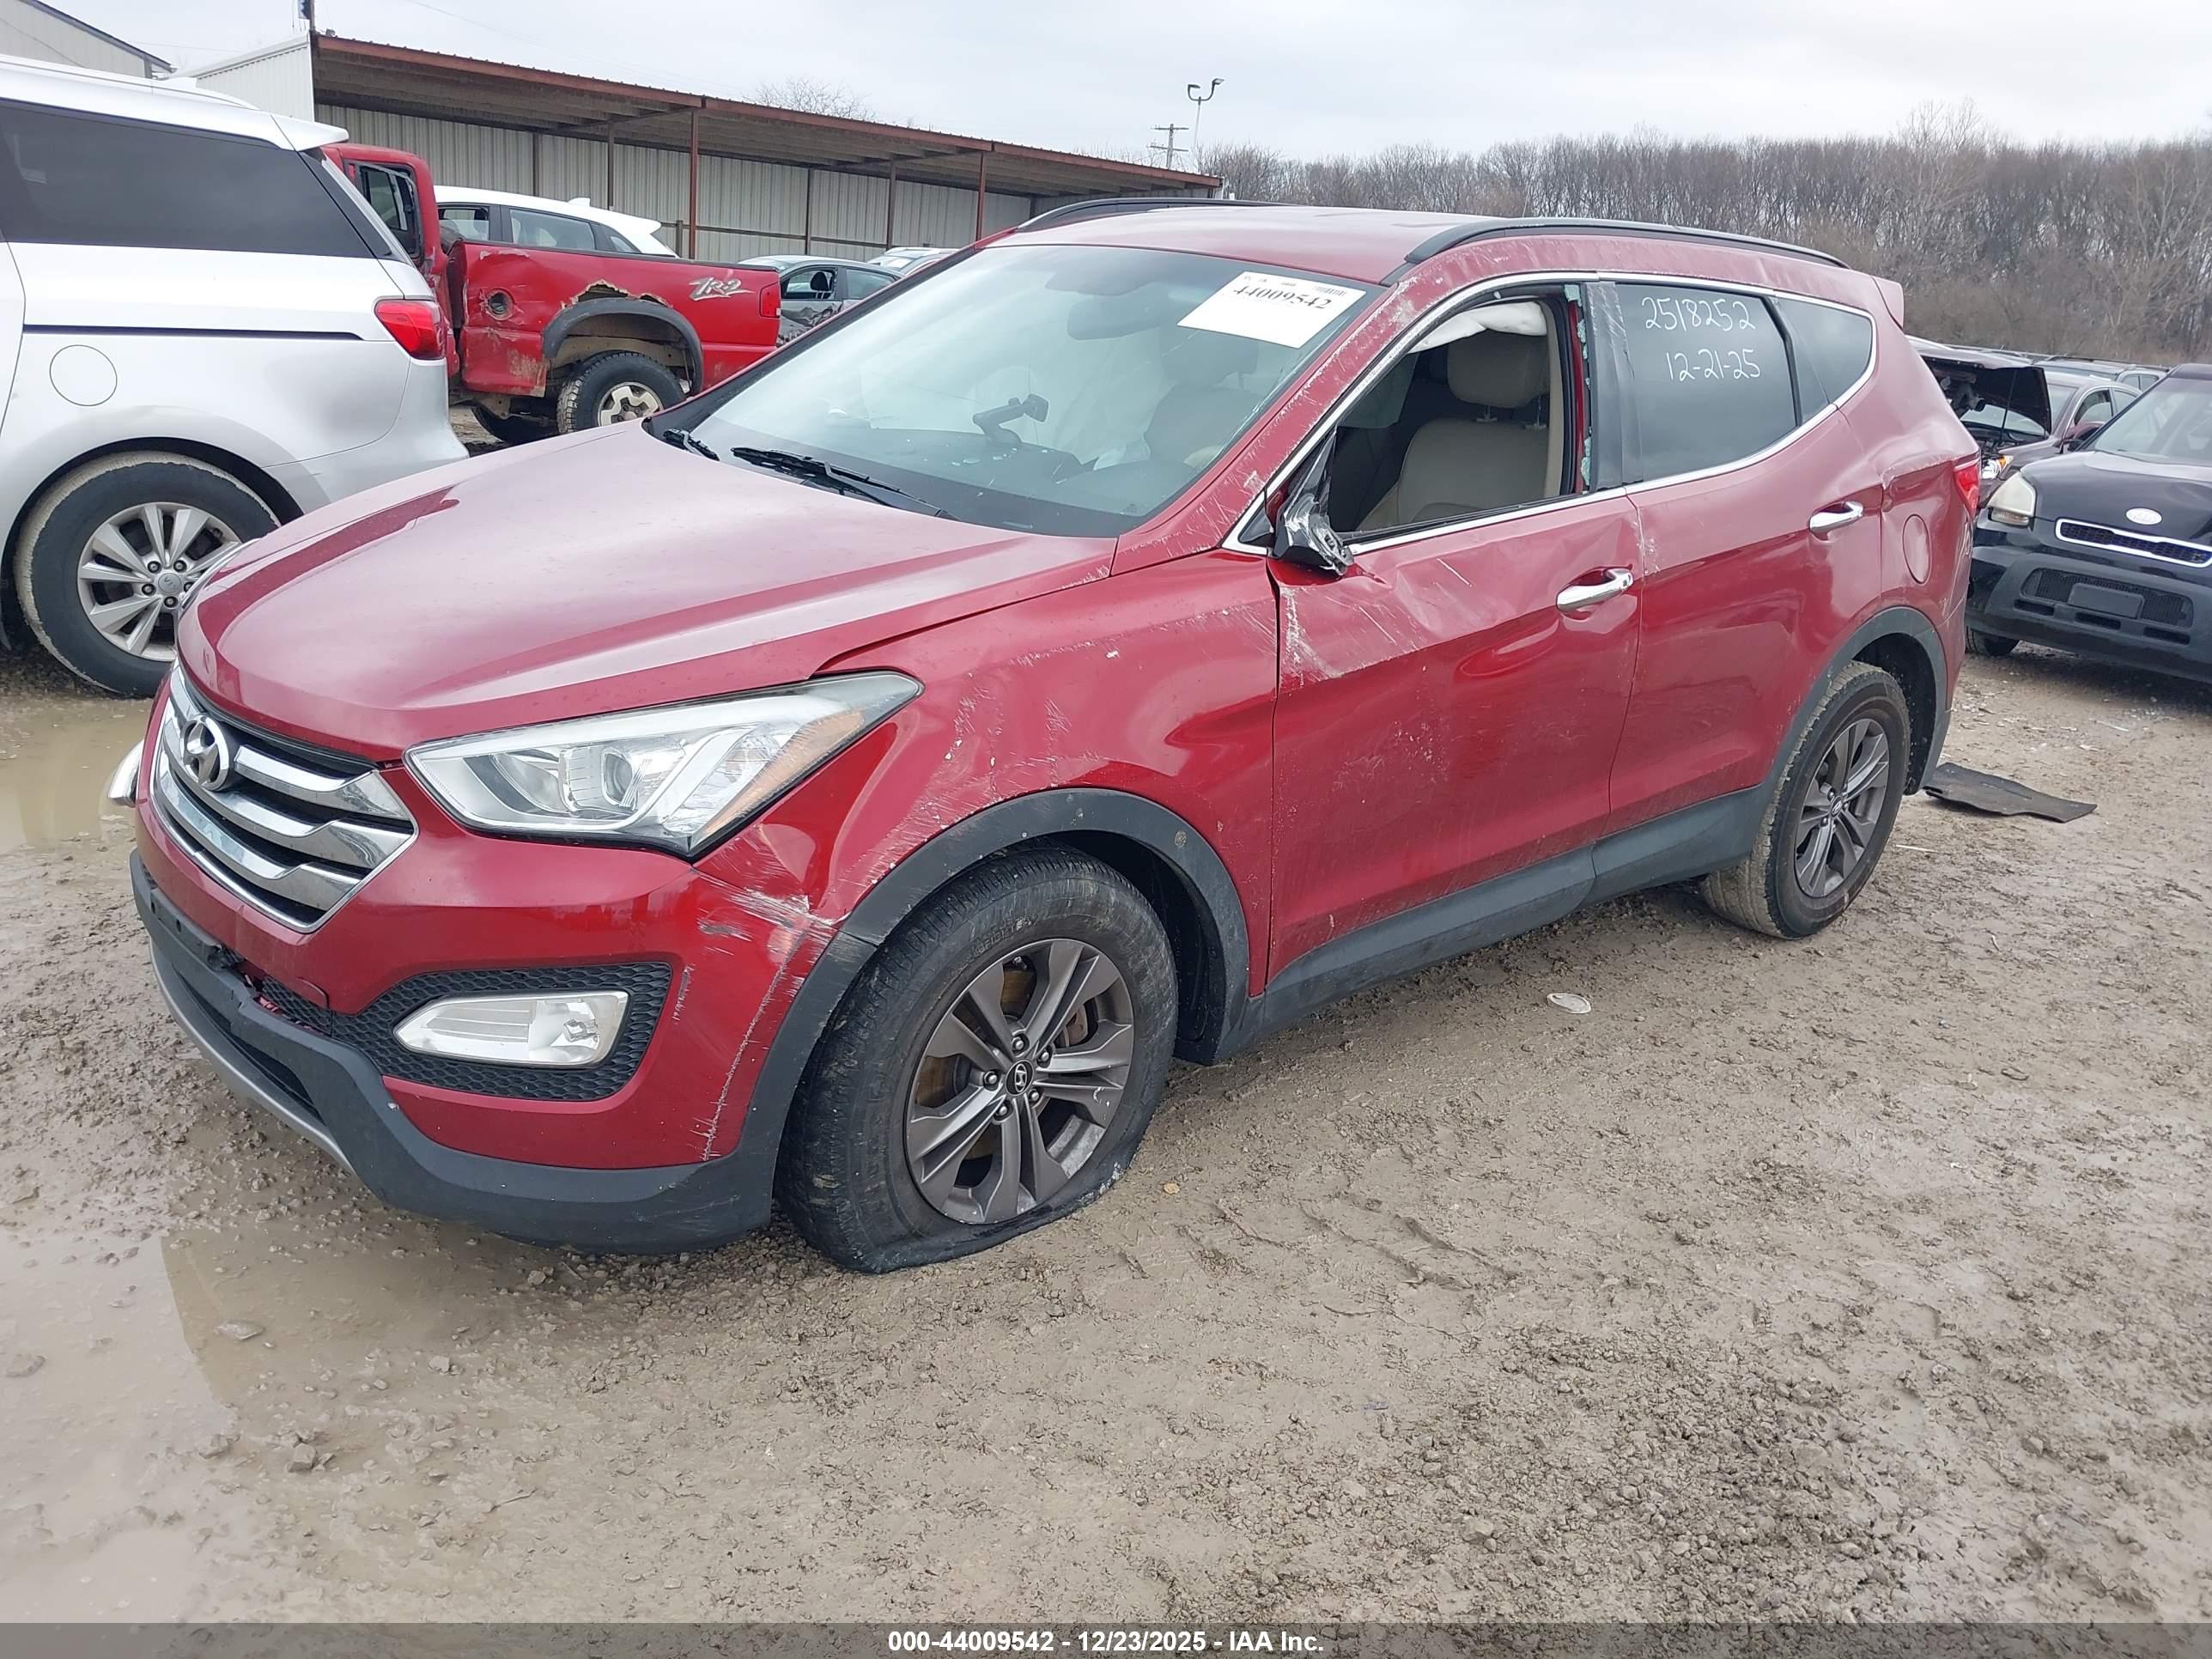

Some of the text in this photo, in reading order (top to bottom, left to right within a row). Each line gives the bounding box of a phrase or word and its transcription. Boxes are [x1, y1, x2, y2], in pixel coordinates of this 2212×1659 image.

[1232, 285, 1333, 310] 44009542
[1641, 296, 1756, 332] 2518252
[1665, 348, 1760, 382] 12-21-25
